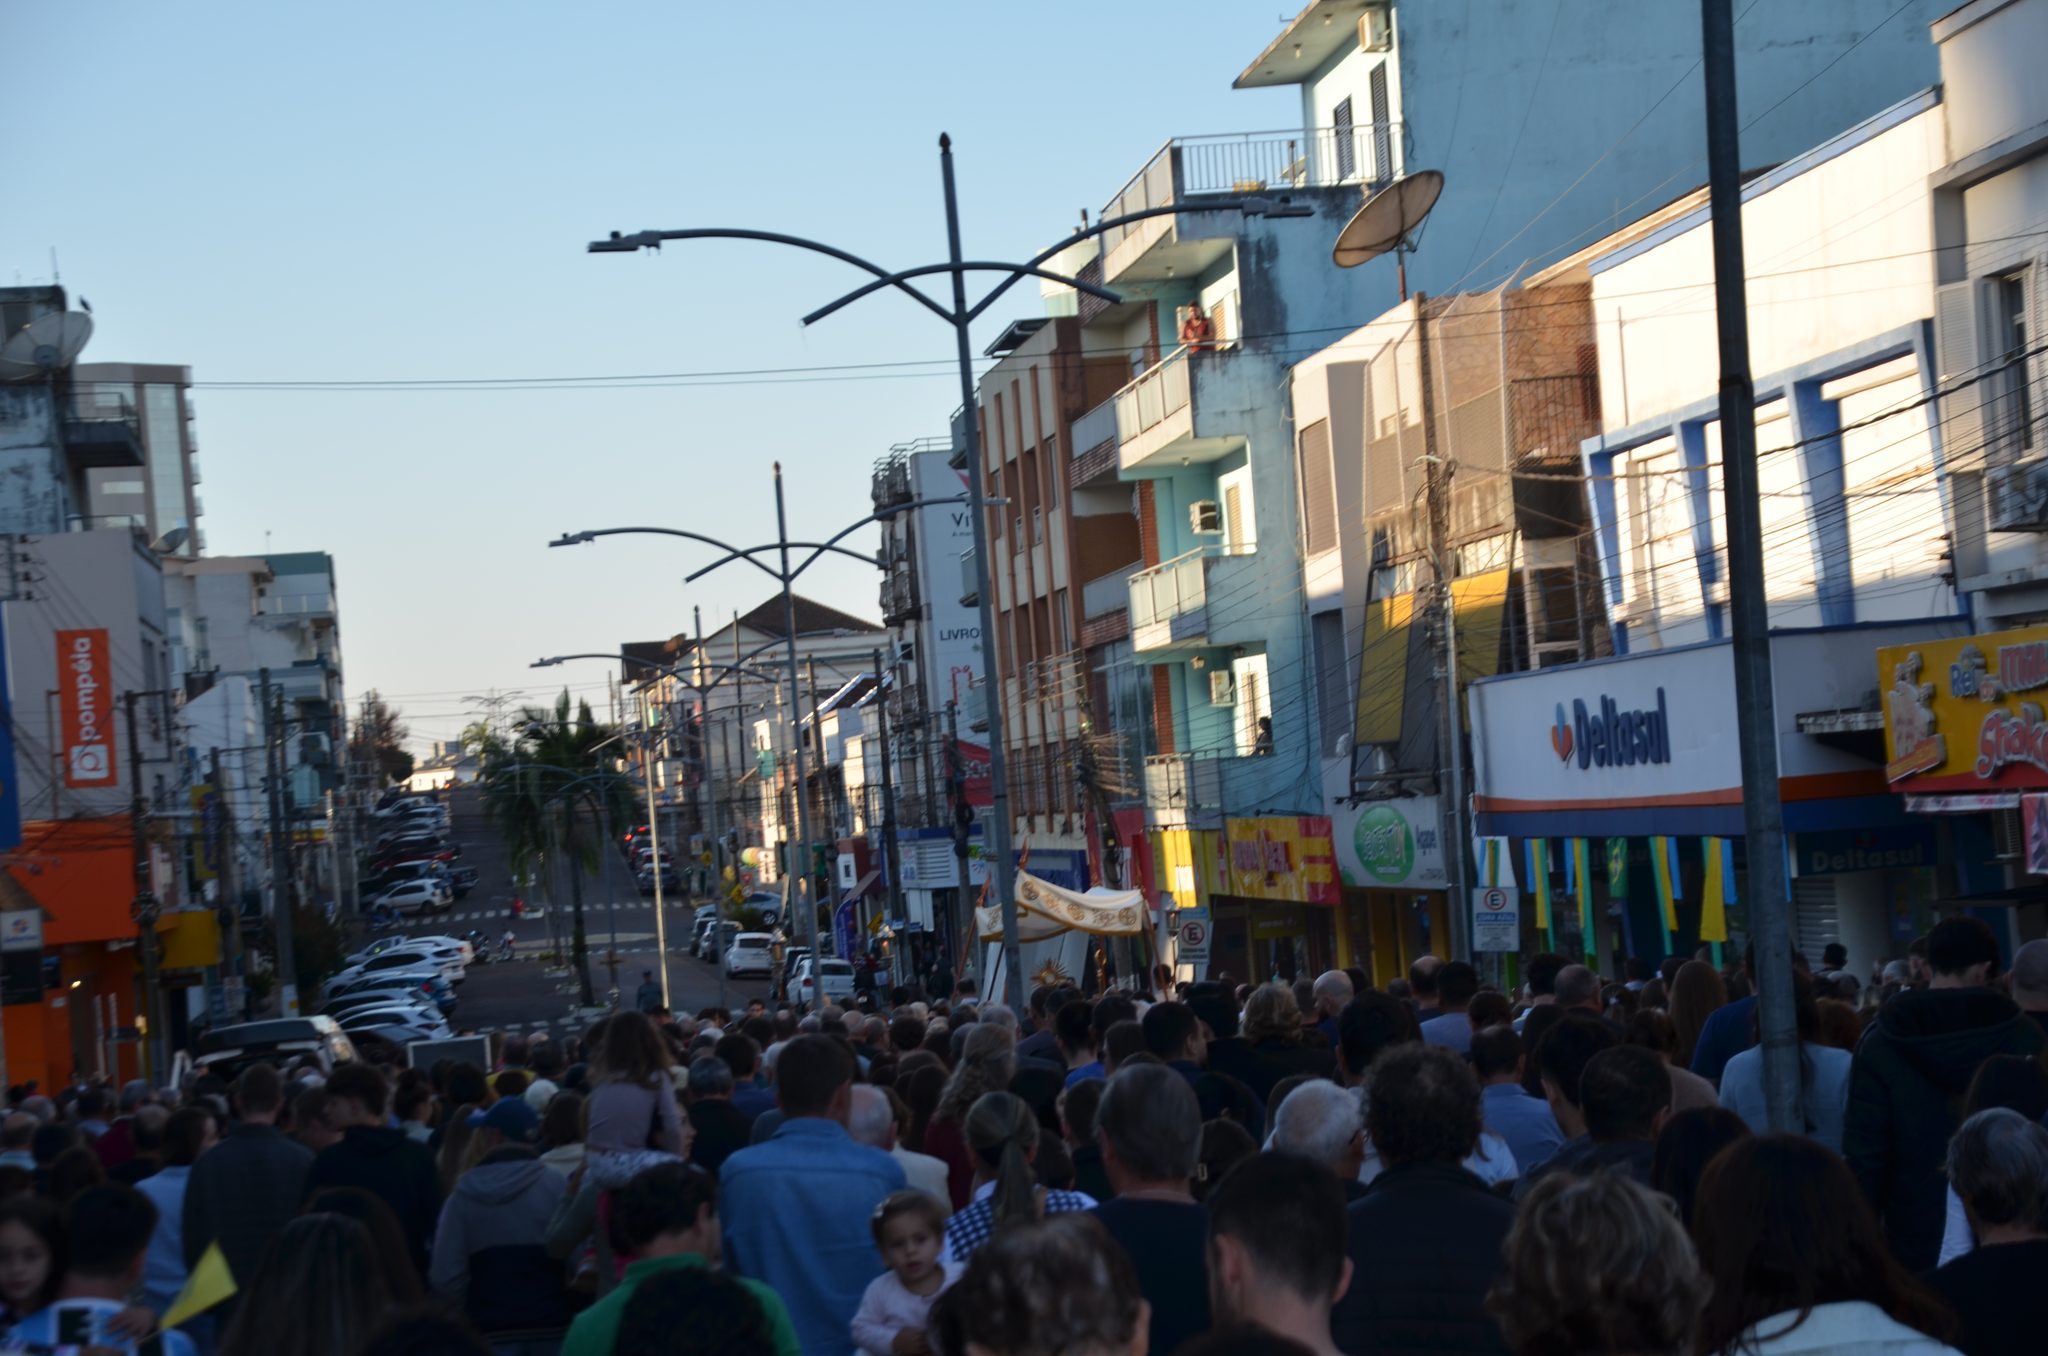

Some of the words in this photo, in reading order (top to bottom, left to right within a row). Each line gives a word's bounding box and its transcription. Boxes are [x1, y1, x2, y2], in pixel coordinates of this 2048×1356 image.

[69, 636, 104, 742] pompéia
[1573, 686, 1671, 770] Deltasul
[1812, 841, 1923, 872] Deltasul
